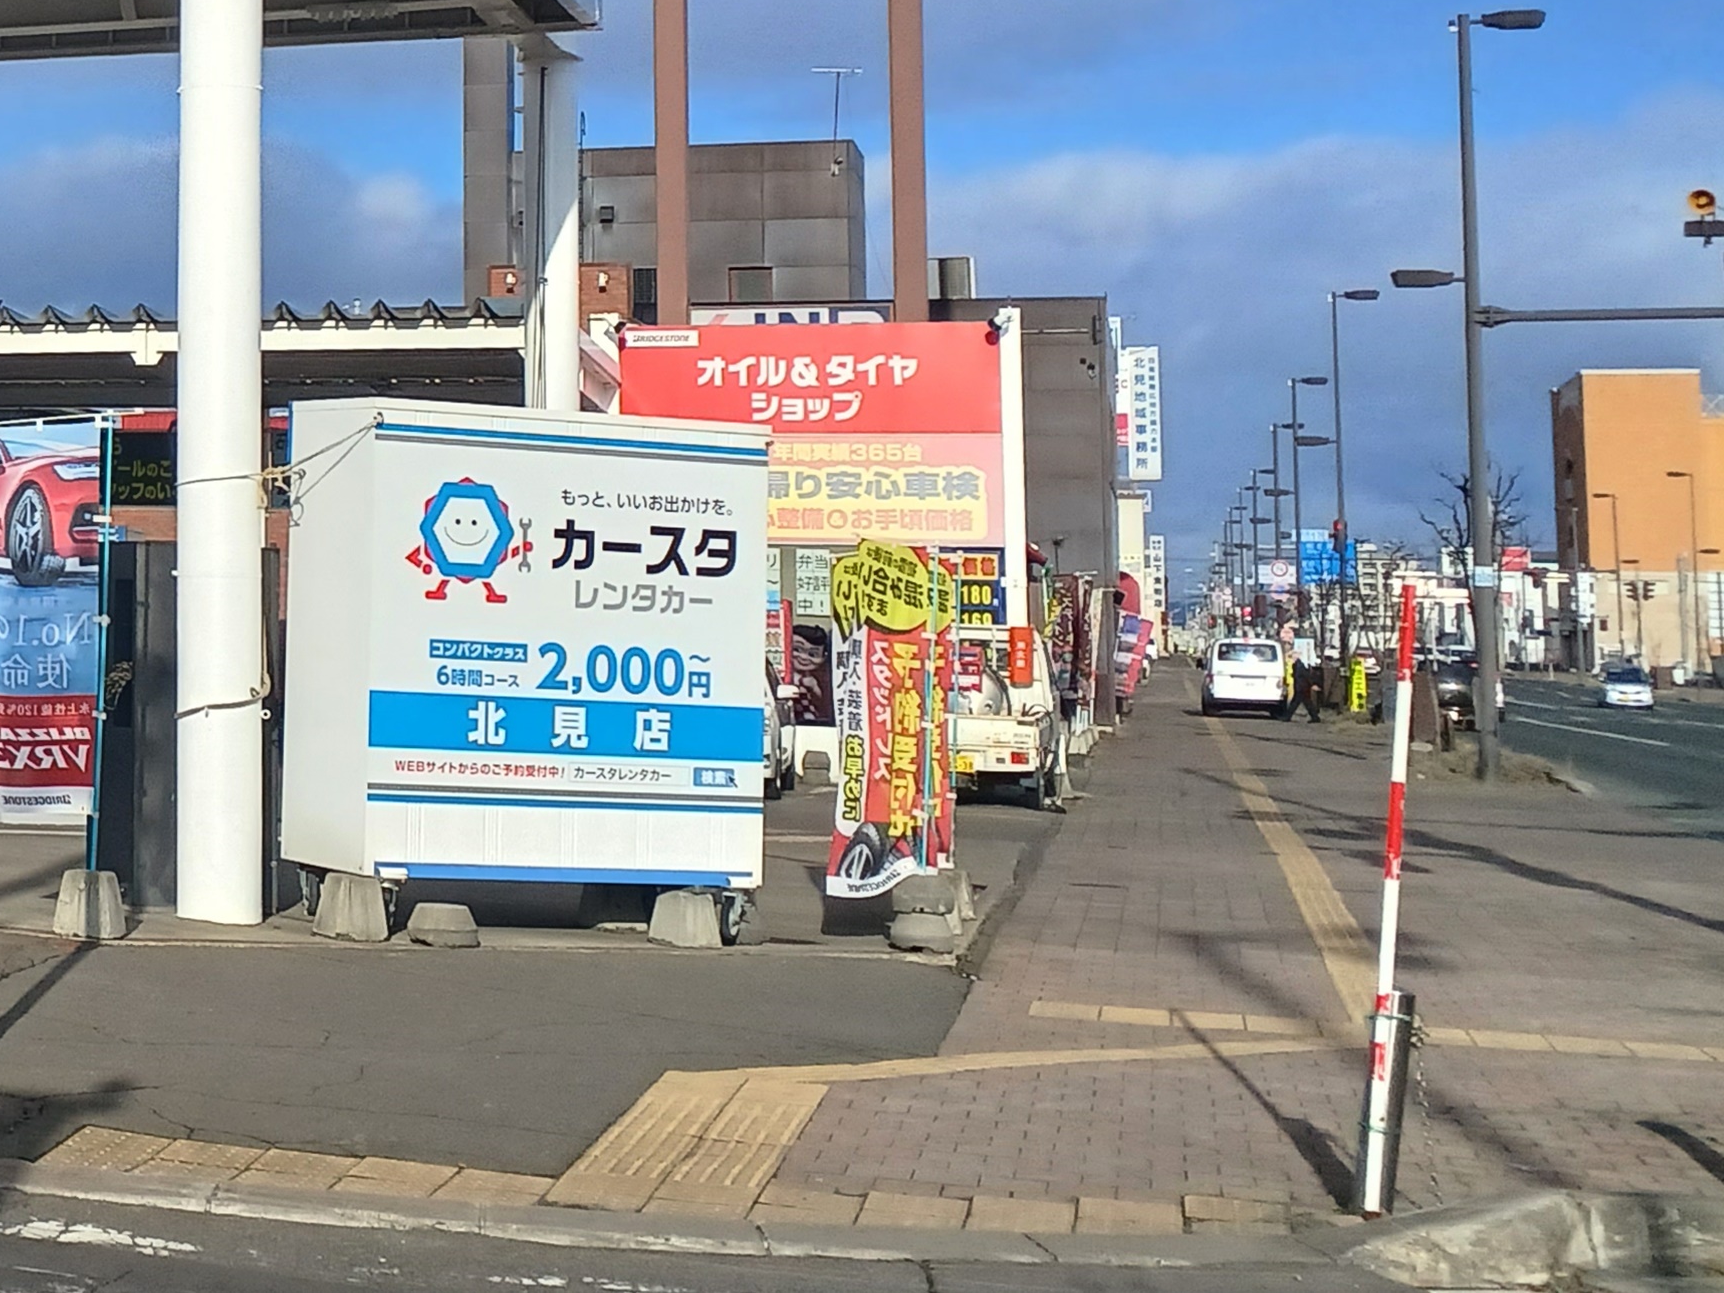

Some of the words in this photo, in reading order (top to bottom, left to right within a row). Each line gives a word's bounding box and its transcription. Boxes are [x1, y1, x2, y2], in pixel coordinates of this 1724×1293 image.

[632, 333, 690, 344] BRIDGESTONE
[750, 391, 863, 422] ショップ
[561, 489, 733, 517] もっと、いいお出かけを。
[551, 518, 738, 578] カースタ
[795, 552, 829, 570] 弁当
[796, 575, 830, 592] 好評
[574, 579, 714, 614] レンタカー
[960, 584, 992, 606] 180
[430, 642, 527, 661] コンパクトクラス
[436, 665, 520, 689] 6時間コース
[536, 642, 685, 696] 2,000
[394, 759, 566, 780] WEBサイトからのご予約受付中!
[573, 765, 673, 783] カースタレンタカー
